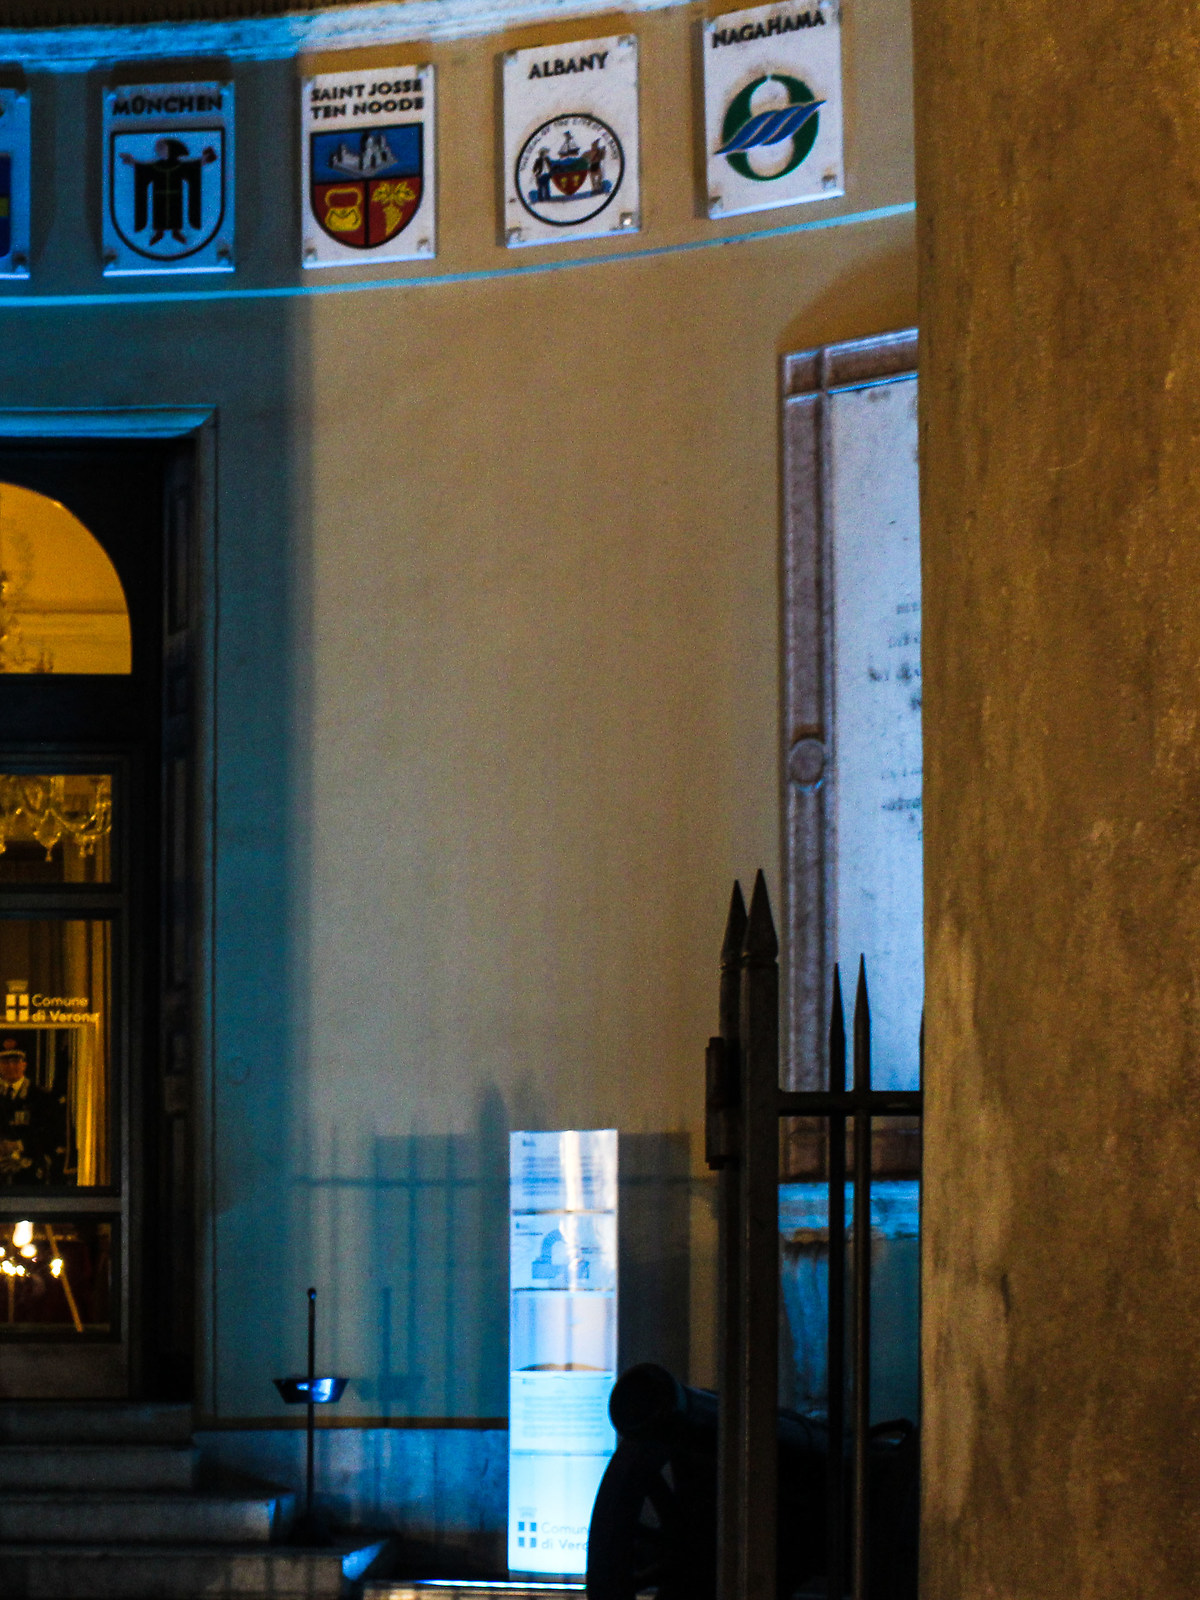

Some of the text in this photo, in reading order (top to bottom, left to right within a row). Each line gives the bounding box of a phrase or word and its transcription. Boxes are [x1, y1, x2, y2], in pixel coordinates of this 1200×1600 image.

[712, 10, 825, 49] NAGAHAMA
[528, 51, 609, 80] ALBANY
[311, 79, 422, 102] SAINT JOSSE
[311, 97, 424, 120] TEN NOODE
[32, 993, 88, 1008] Comune
[32, 1009, 100, 1023] di Verona
[541, 1521, 588, 1535] Comun
